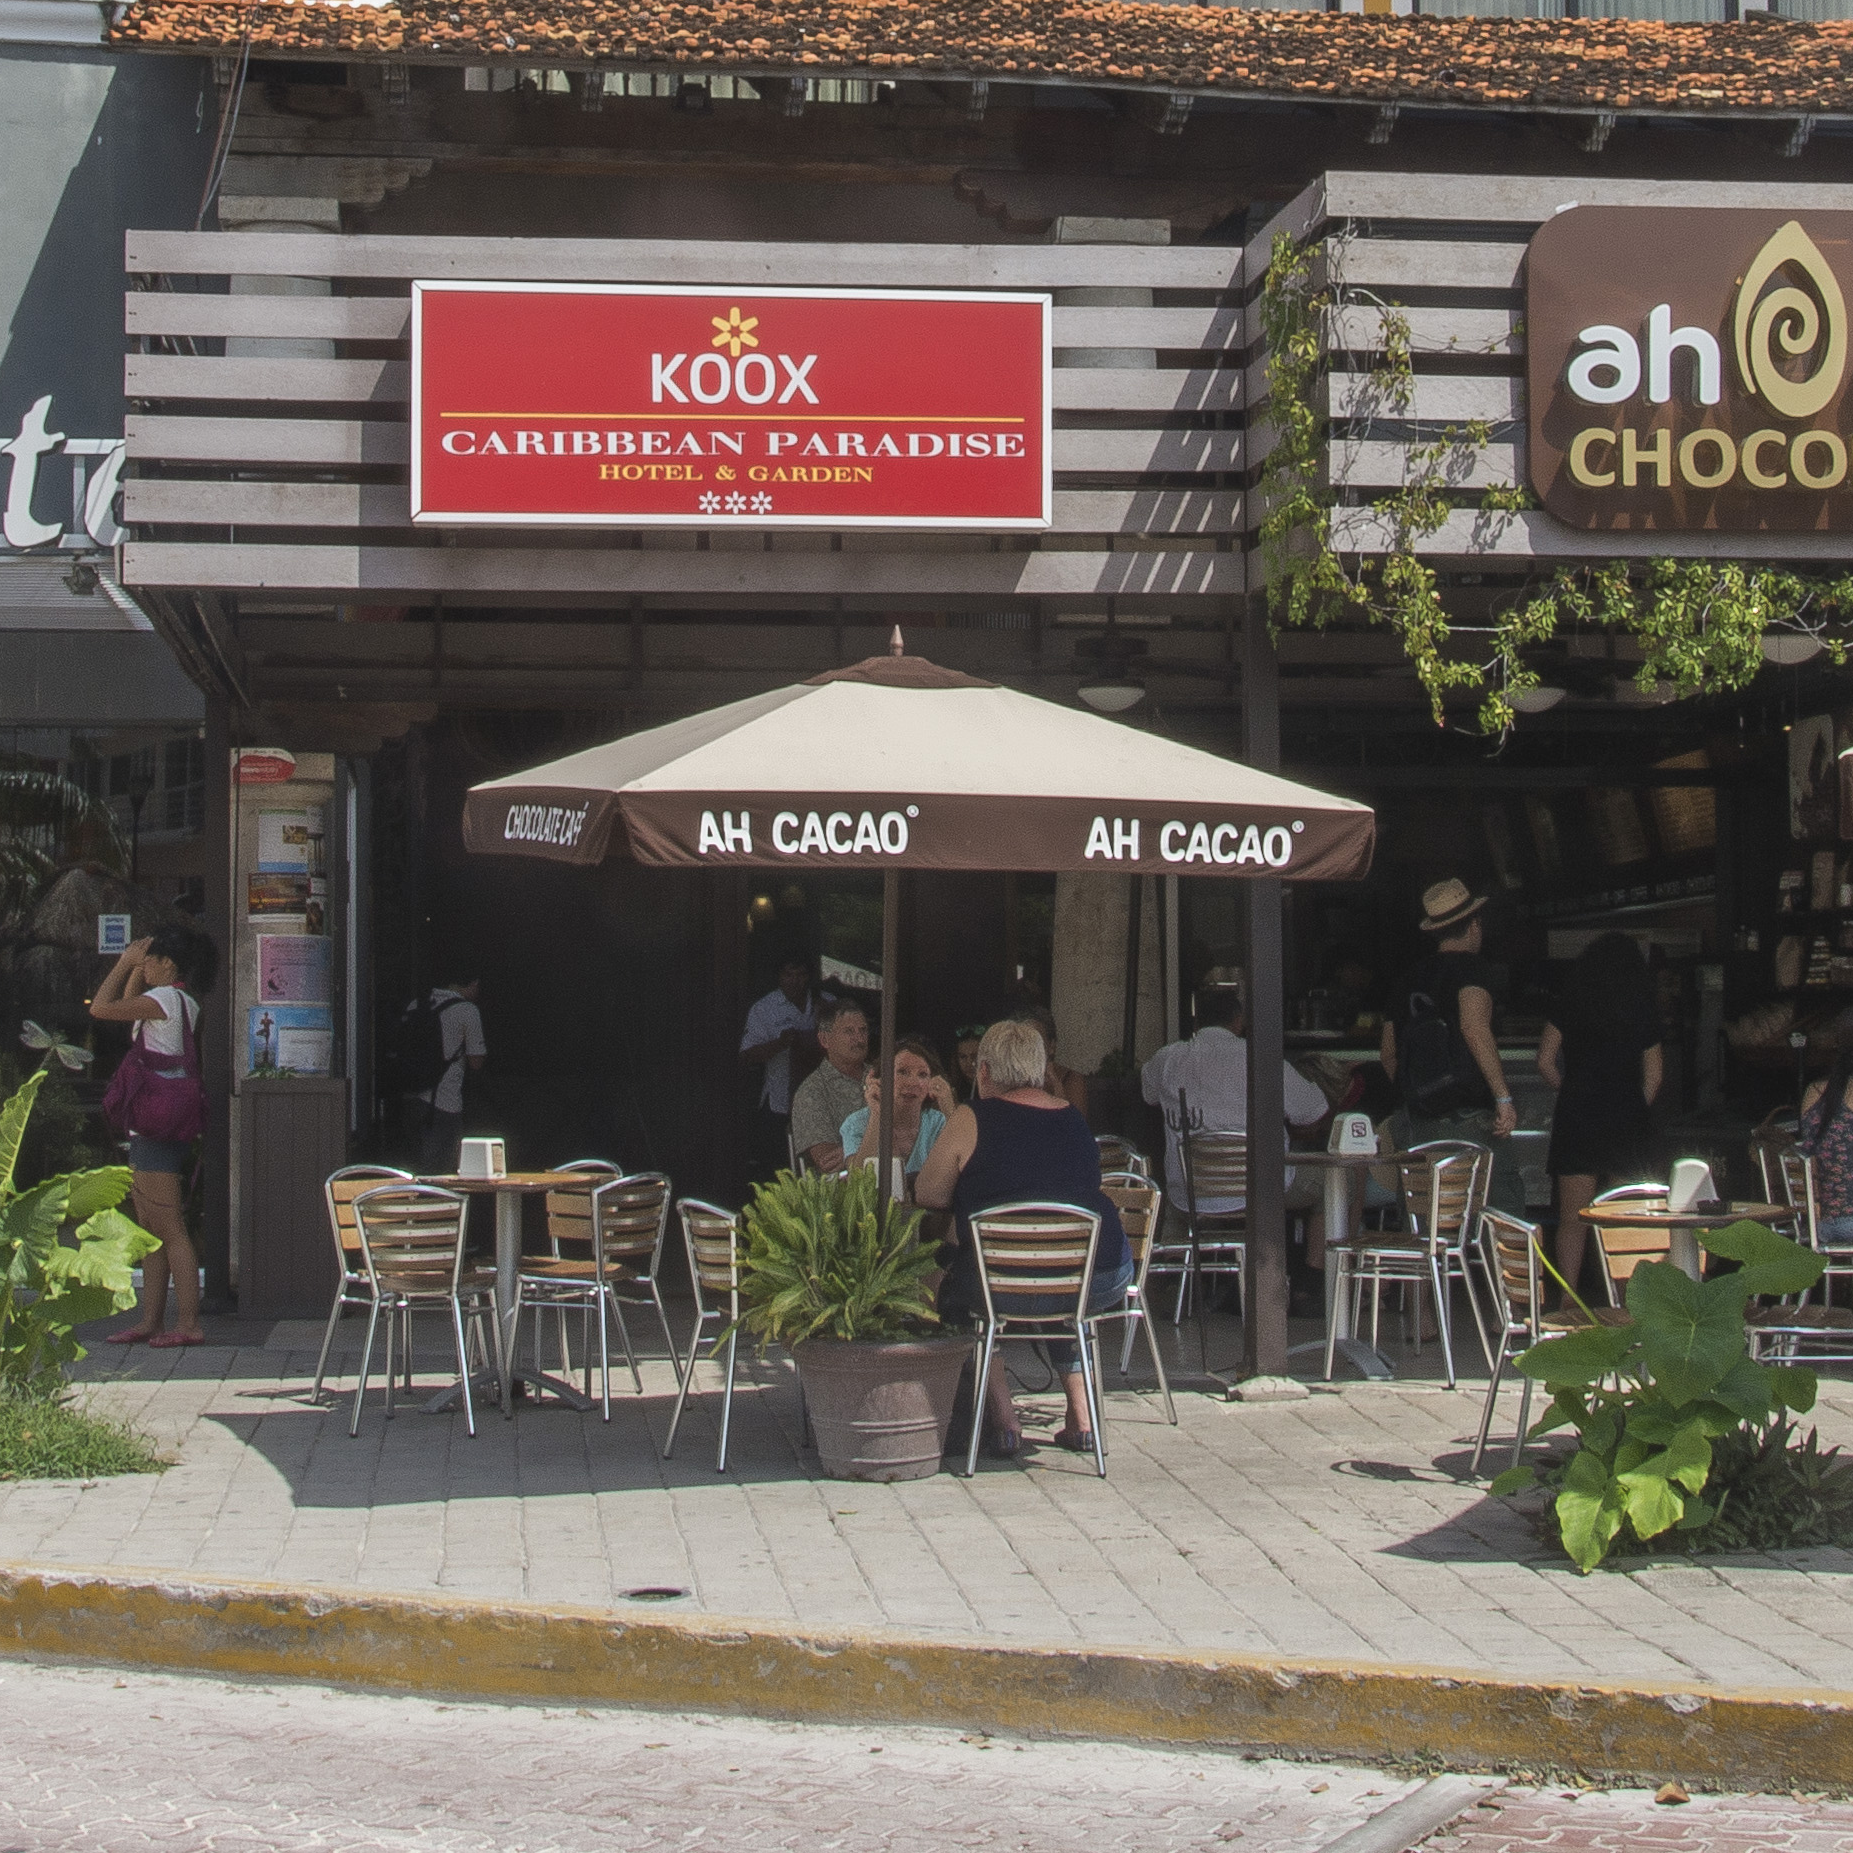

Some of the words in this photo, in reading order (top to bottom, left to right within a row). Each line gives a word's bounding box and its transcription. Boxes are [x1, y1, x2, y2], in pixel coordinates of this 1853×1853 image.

[1567, 303, 1722, 406] ah
[651, 353, 820, 405] KOOX
[441, 430, 745, 457] CARIBBEAN
[766, 431, 1025, 459] PARADISE
[599, 463, 703, 482] HOTEL
[715, 465, 737, 482] &
[748, 465, 875, 484] GARDEN
[504, 804, 563, 844] CHOCOLATE
[699, 810, 753, 855] AH
[1084, 816, 1141, 861] AH
